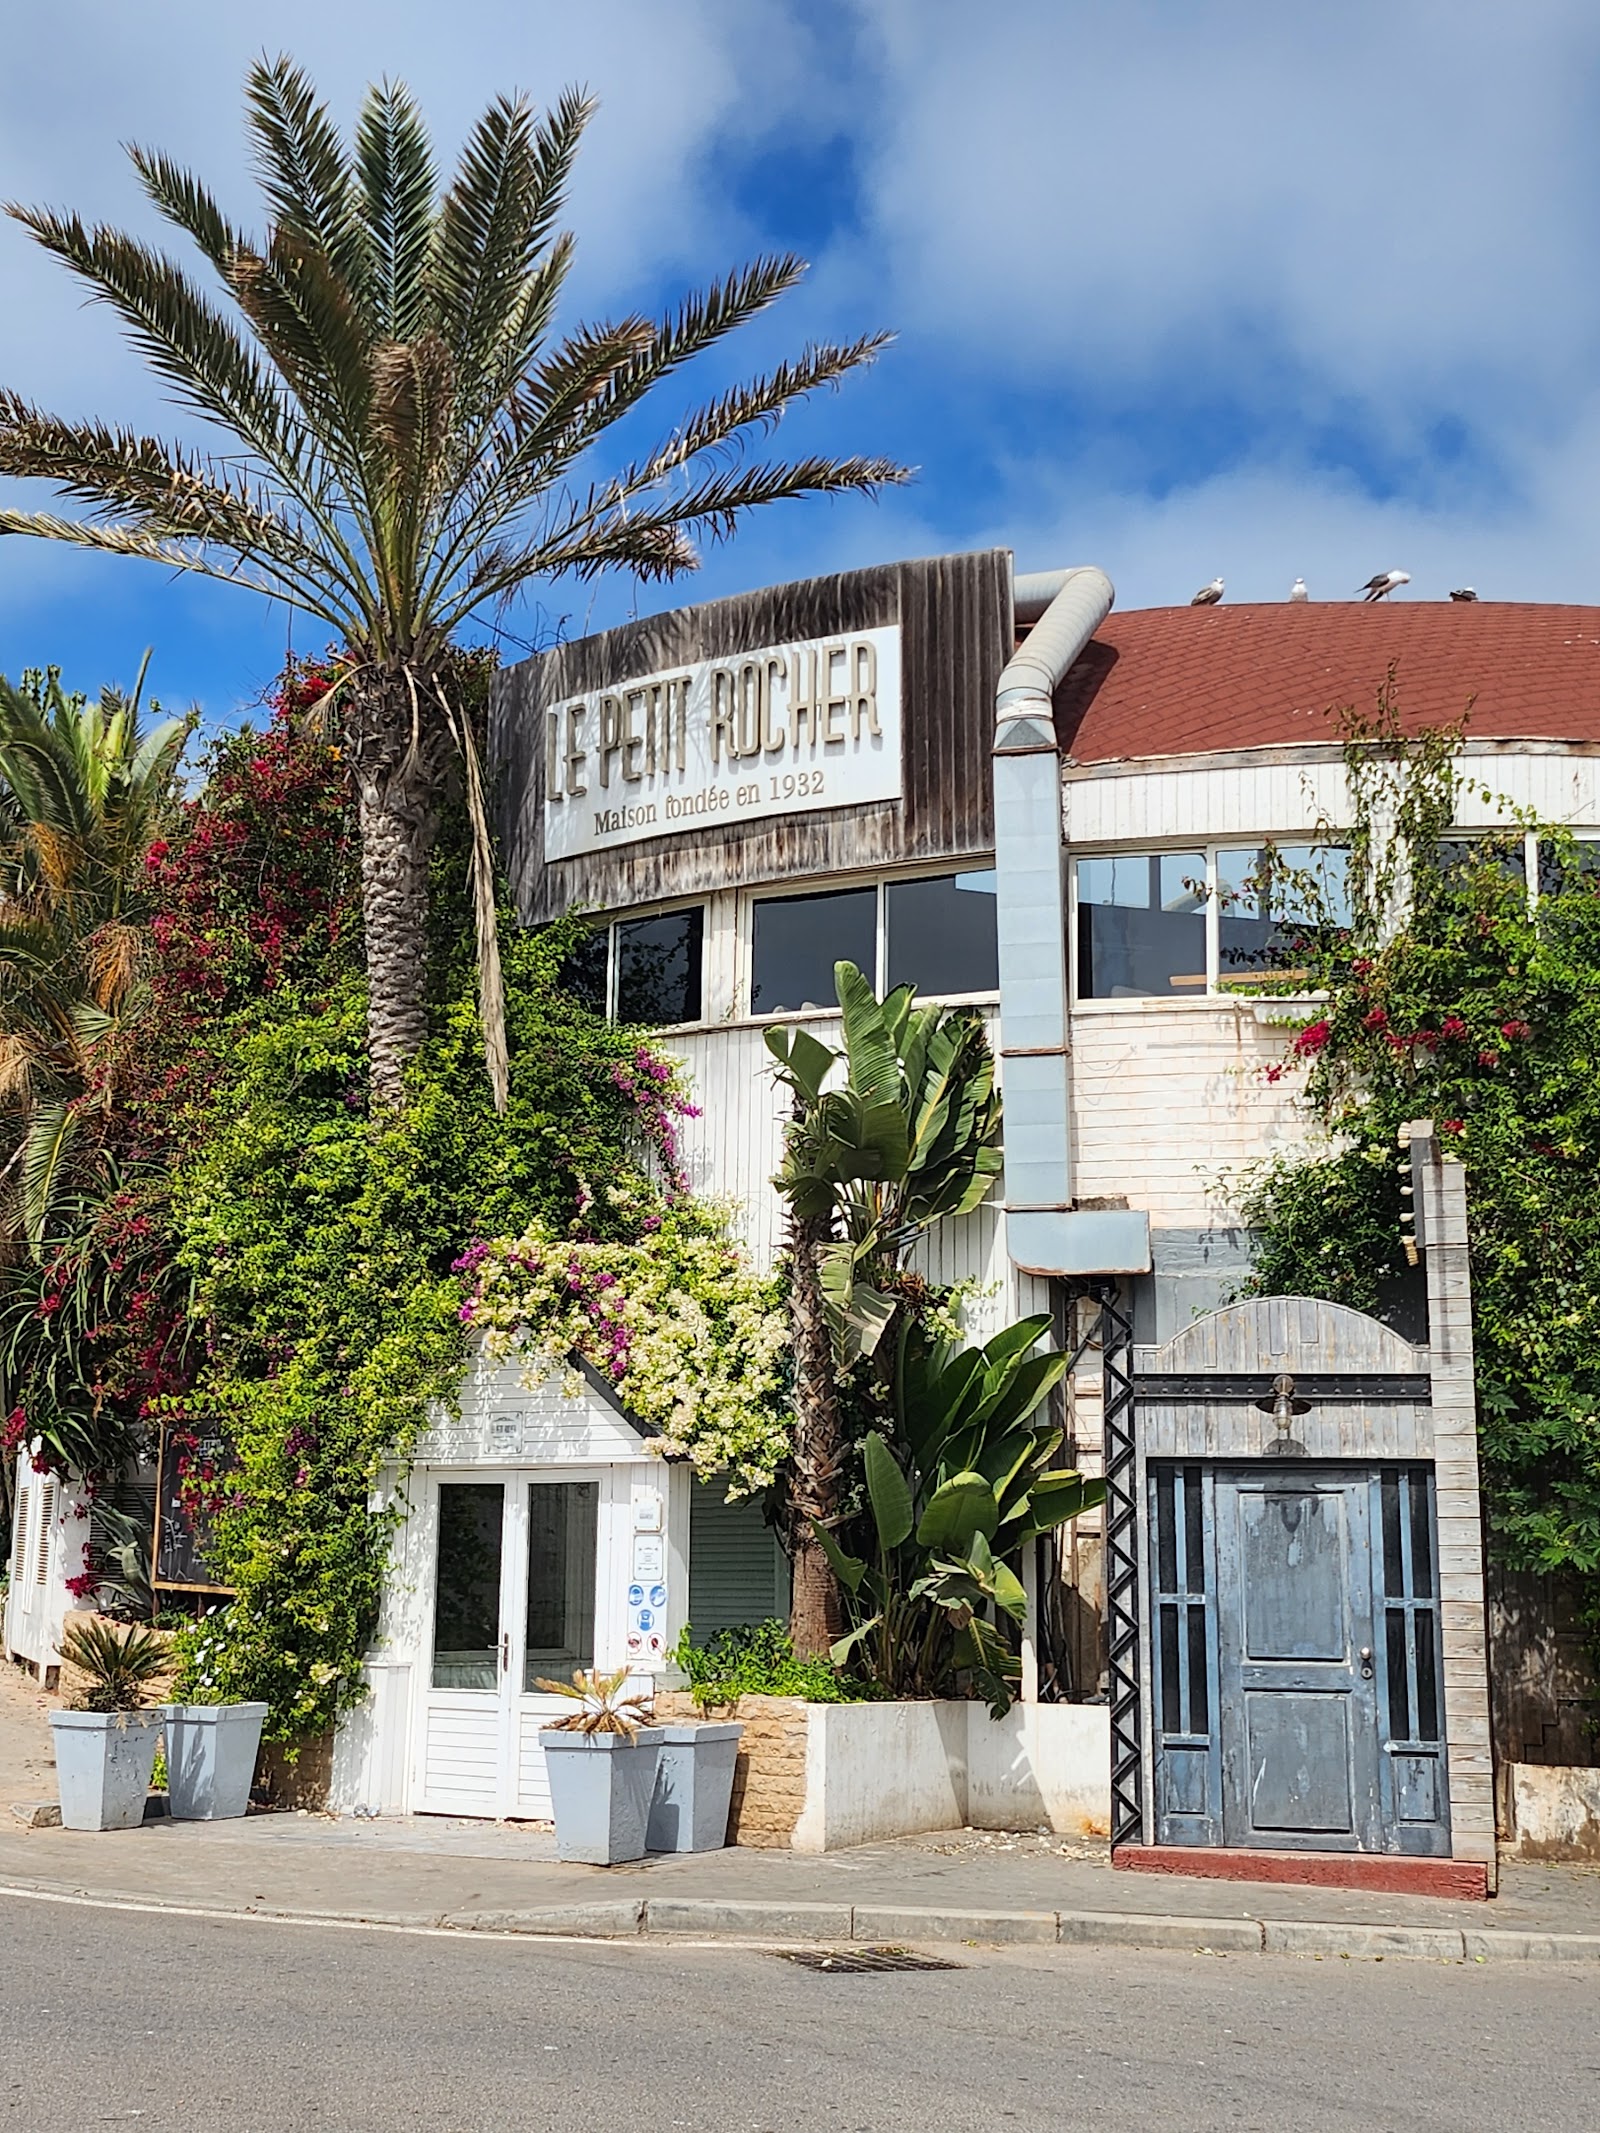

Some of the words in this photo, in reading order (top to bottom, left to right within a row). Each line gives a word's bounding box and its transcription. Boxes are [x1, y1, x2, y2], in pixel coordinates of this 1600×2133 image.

[546, 703, 587, 803] LE
[596, 675, 692, 789] PETIT
[706, 640, 882, 763] ROCHER
[594, 804, 657, 836] Maison
[665, 785, 730, 819] fondée
[736, 782, 761, 806] en
[769, 770, 825, 800] 1932
